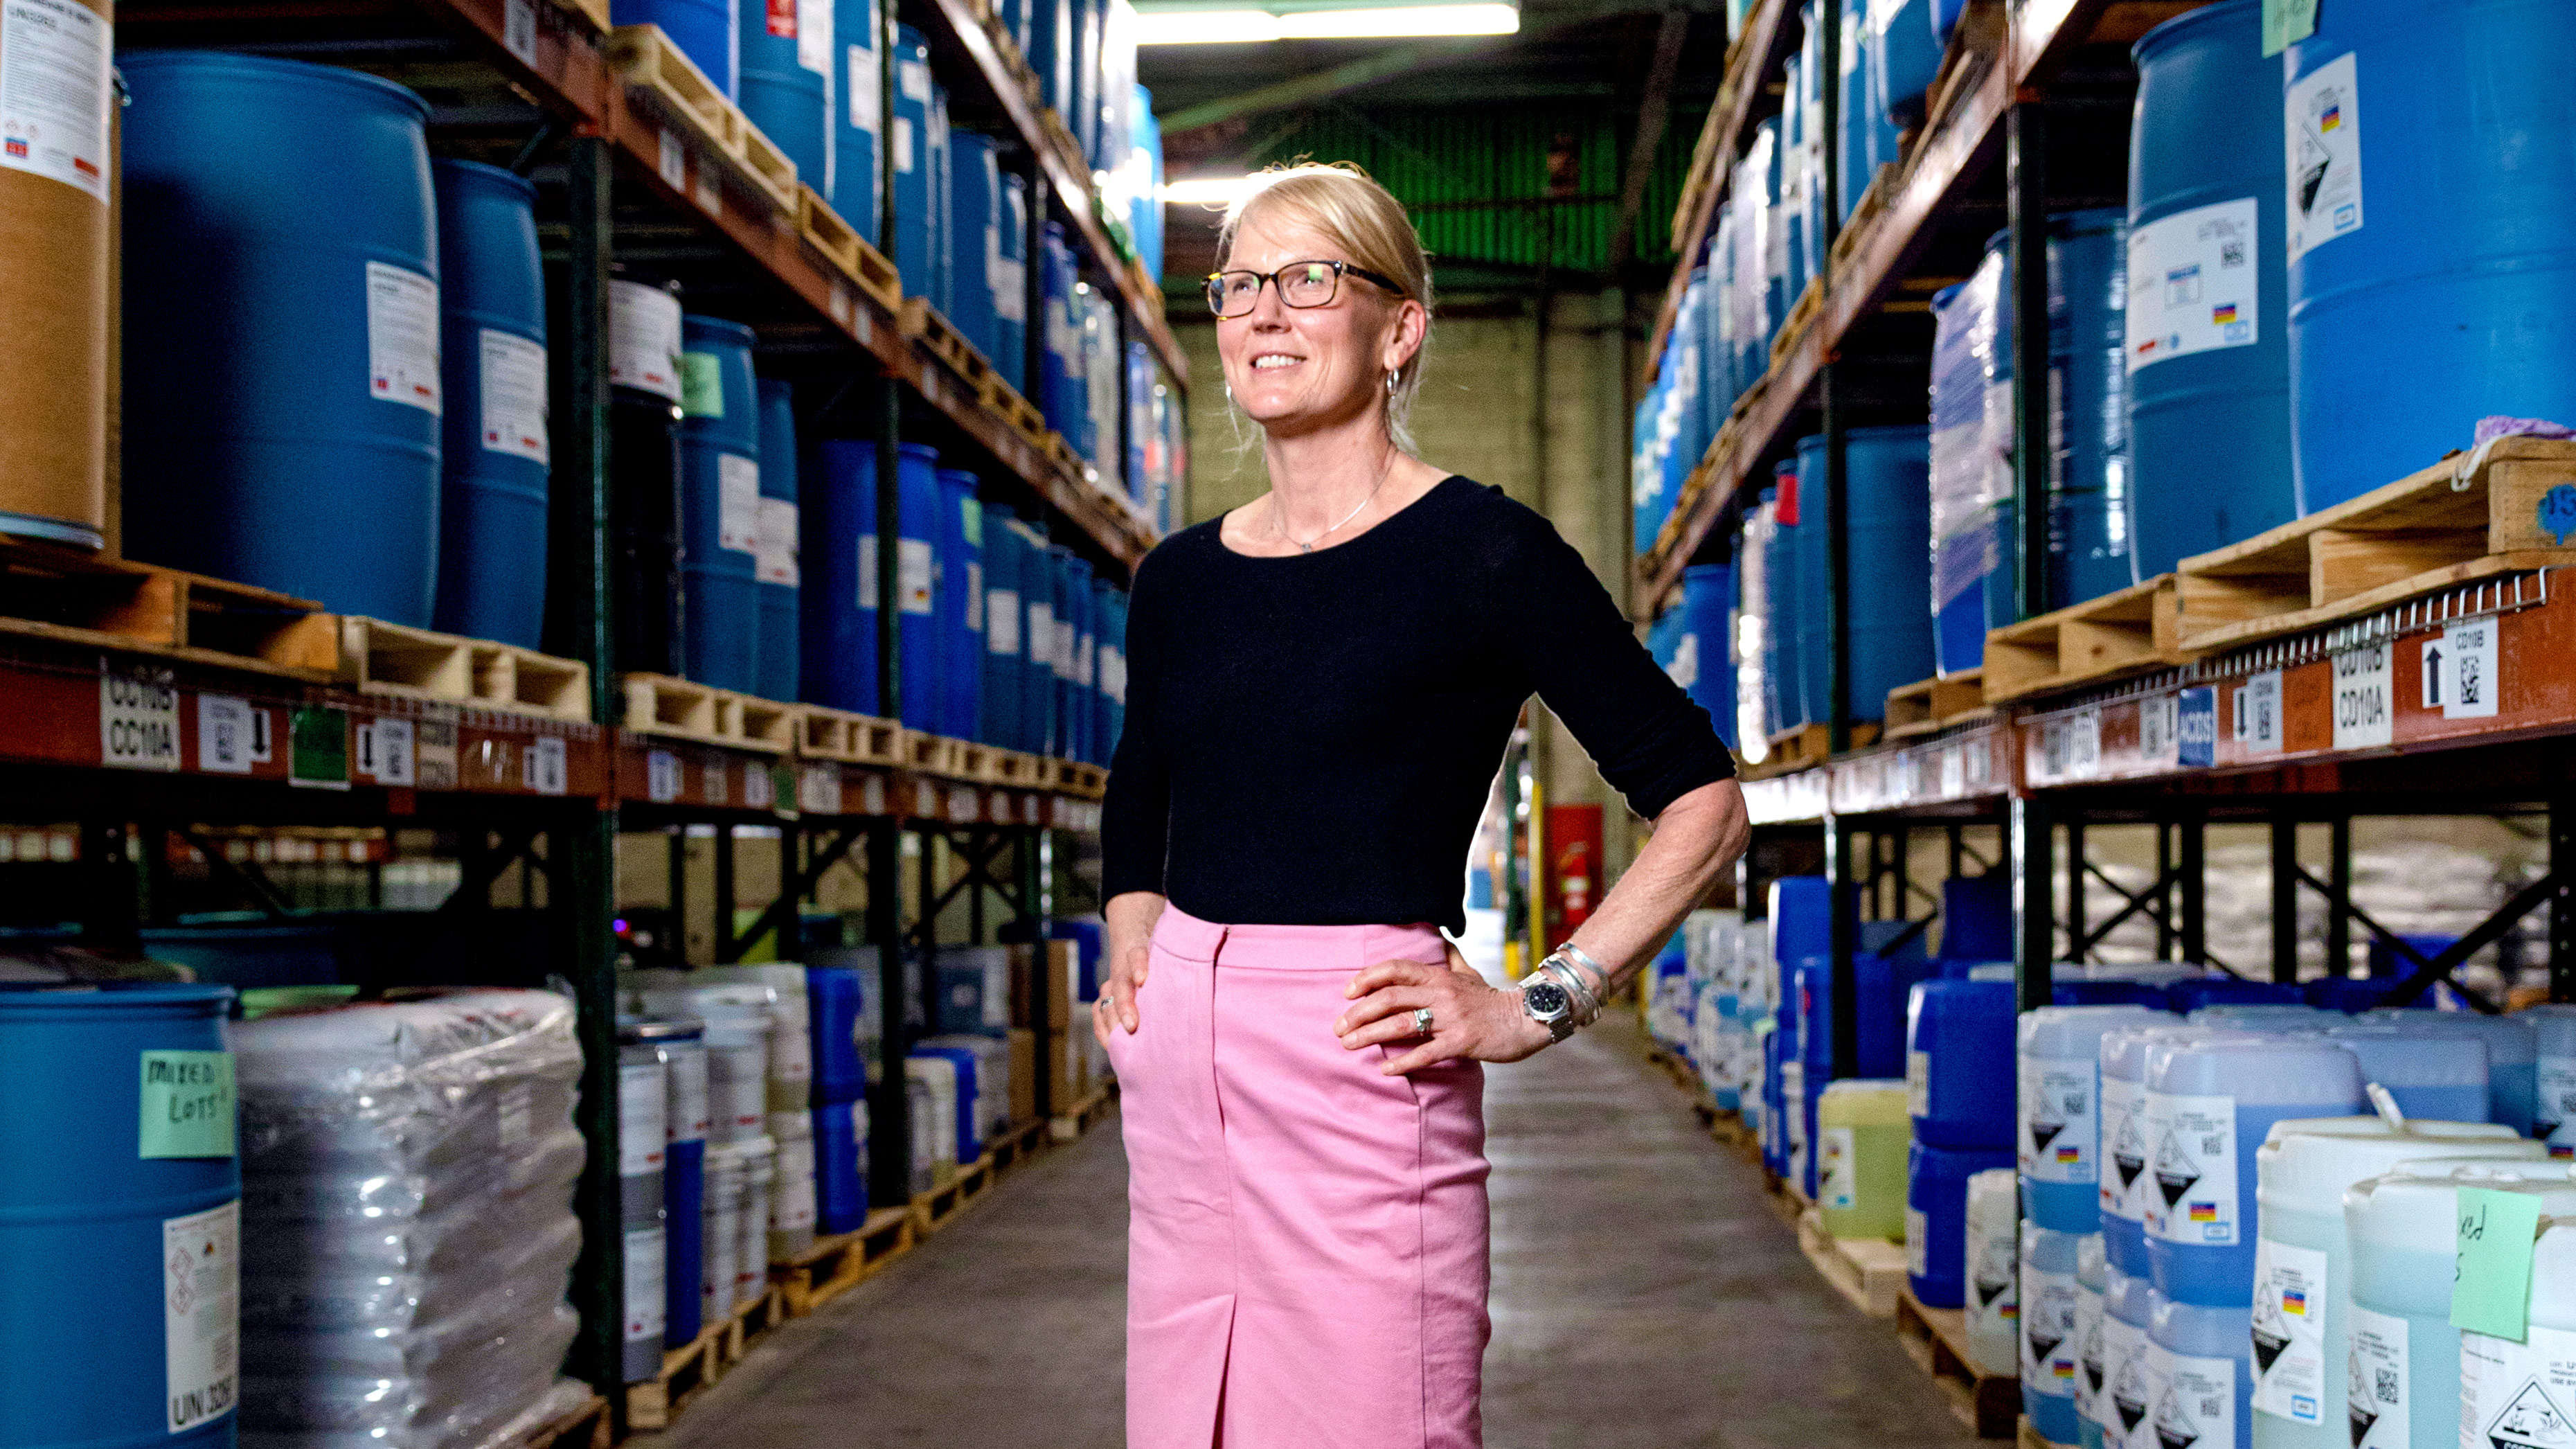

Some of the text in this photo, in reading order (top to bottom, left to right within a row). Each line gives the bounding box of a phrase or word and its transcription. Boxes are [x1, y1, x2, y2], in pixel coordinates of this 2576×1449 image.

[2456, 629, 2484, 650] CD10B
[2338, 686, 2384, 728] CD10A
[2179, 711, 2213, 745] ACIDS
[147, 1059, 215, 1085] MIXED
[172, 1389, 204, 1426] UN
